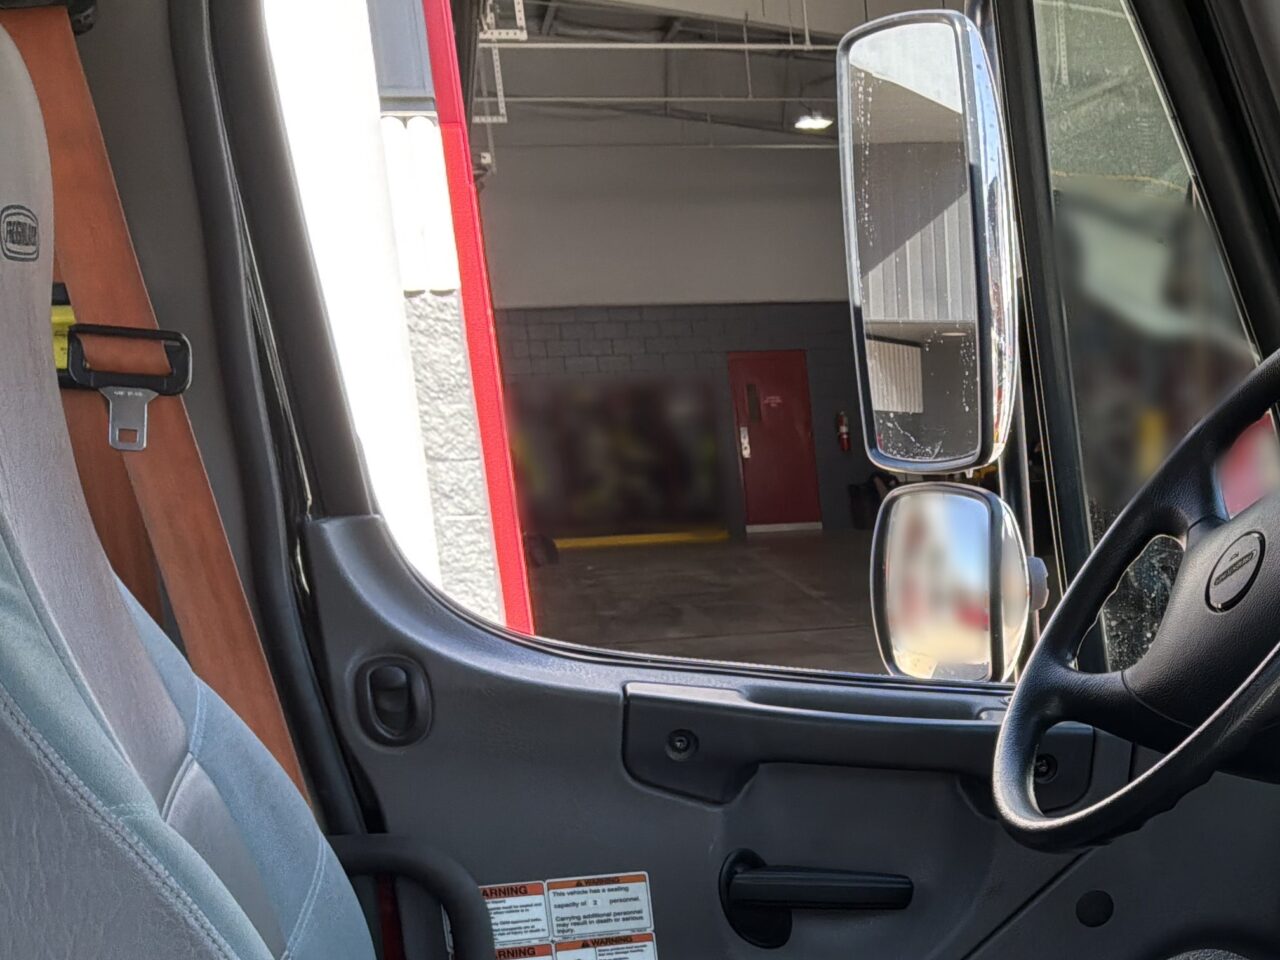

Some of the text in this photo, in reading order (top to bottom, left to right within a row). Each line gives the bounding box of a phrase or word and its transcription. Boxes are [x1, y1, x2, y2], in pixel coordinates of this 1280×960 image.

[554, 901, 580, 909] capacity
[555, 915, 582, 923] Carrying
[613, 909, 644, 918] personnel
[591, 935, 633, 948] WARNING
